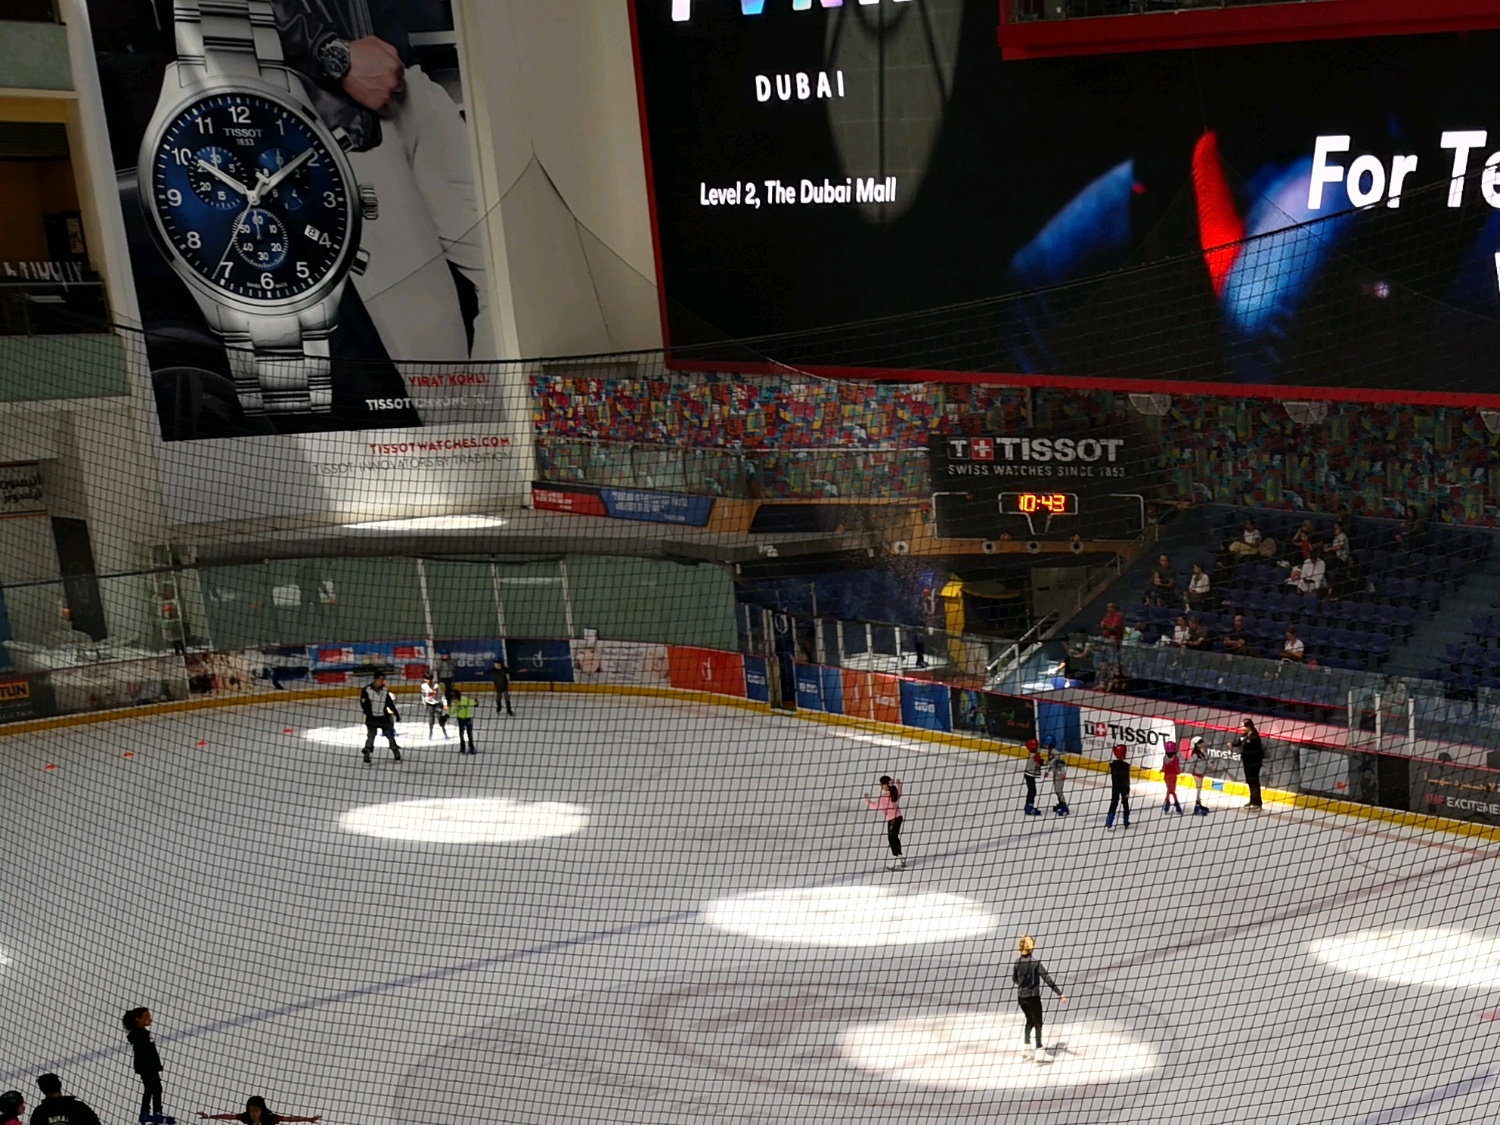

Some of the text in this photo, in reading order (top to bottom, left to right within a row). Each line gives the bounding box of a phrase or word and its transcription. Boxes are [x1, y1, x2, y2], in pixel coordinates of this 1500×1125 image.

[755, 71, 845, 102] DUBAI
[227, 105, 253, 124] 12
[195, 116, 214, 135] 11
[222, 127, 264, 139] TISSOT
[275, 118, 285, 137] 1
[171, 147, 192, 166] 10
[1307, 134, 1417, 210] For
[166, 188, 182, 207] 9
[322, 190, 338, 209] 3
[700, 176, 897, 209] Level 2, The Dubai Mall
[186, 231, 202, 250] 8
[318, 231, 333, 249] 4
[220, 261, 235, 279] 7
[295, 261, 311, 279] 5
[259, 272, 275, 291] 6
[408, 375, 445, 387] VIRAT
[365, 397, 412, 411] TISSOT
[369, 436, 511, 455] TISSOTWATCHES.COM
[996, 436, 1125, 463] TISSOT
[948, 464, 1126, 478] SWISS WATCHES SINCE 1853
[1018, 493, 1066, 513] 10:43
[1107, 723, 1171, 746] TISSOT
